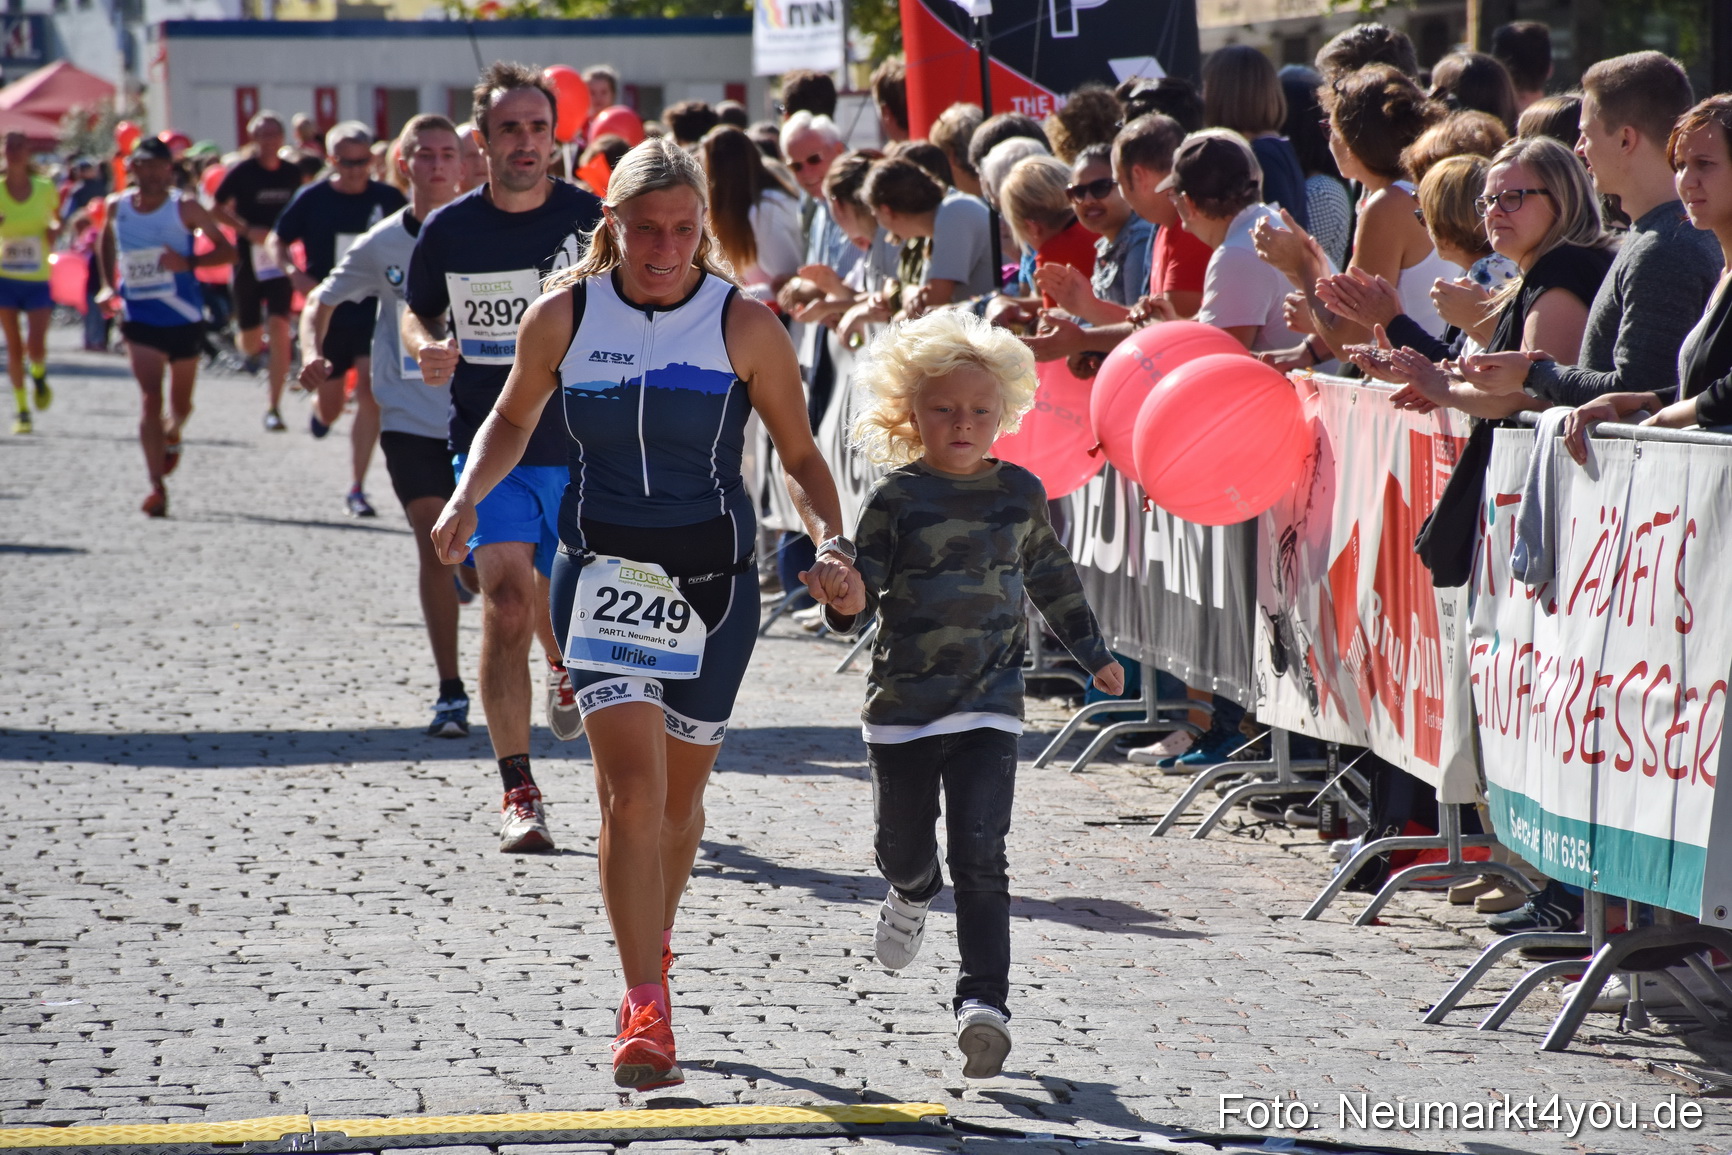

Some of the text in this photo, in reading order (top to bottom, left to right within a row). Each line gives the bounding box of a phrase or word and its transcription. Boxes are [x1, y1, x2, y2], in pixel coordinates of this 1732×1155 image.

[1011, 95, 1049, 114] THE
[471, 281, 514, 293] BOCK
[465, 298, 528, 327] 2392
[590, 350, 635, 362] ATSV
[619, 567, 673, 589] BOCK
[579, 611, 586, 619] D
[592, 586, 691, 634] 2249
[599, 627, 666, 645] PARTL Neumarkt
[611, 645, 657, 667] Ulrike
[580, 682, 629, 709] ATSV
[600, 693, 632, 704] TRIATHLON
[663, 709, 699, 734] SV
[1553, 656, 1728, 789] BESSER
[666, 724, 696, 740] TRIATHLON
